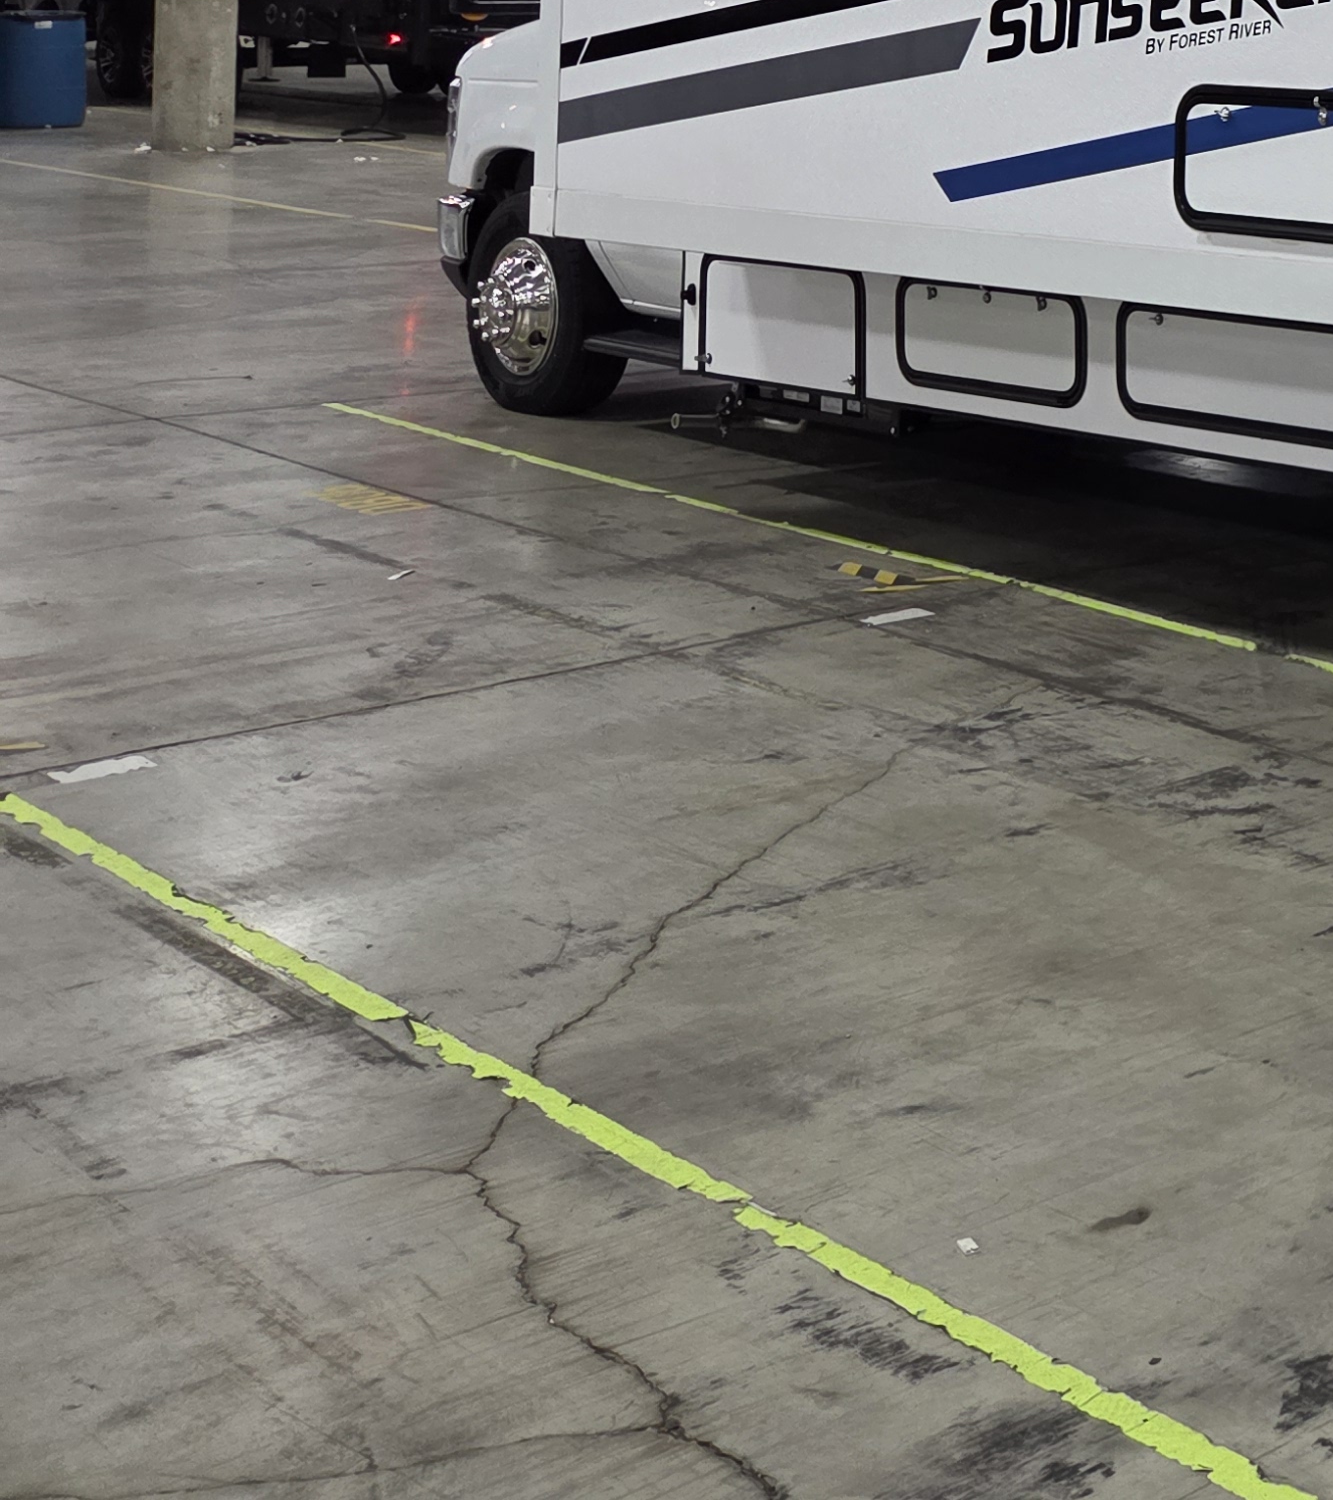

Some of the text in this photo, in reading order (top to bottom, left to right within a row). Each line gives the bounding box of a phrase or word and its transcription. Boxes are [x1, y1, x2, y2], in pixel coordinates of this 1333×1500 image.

[1145, 19, 1272, 55] BY FOREST RIVER
